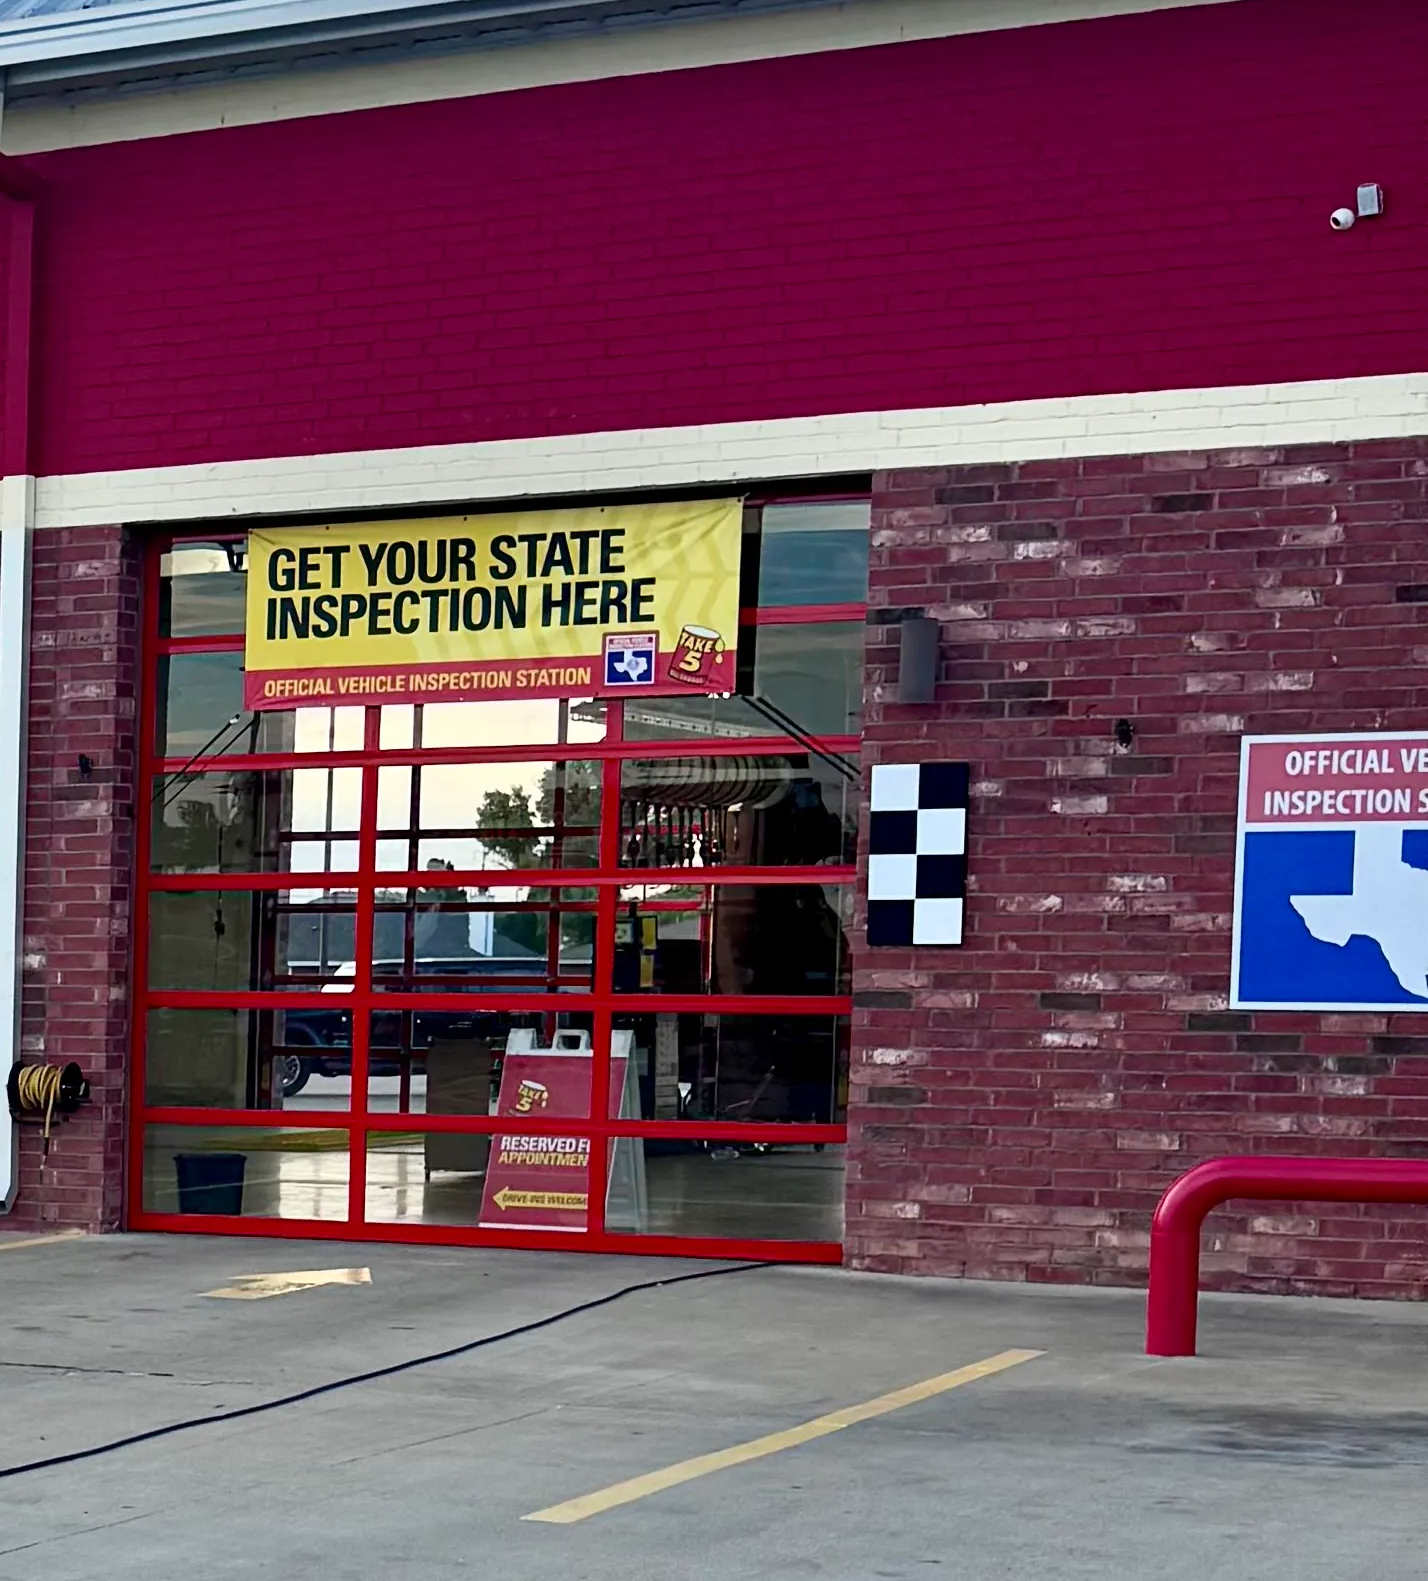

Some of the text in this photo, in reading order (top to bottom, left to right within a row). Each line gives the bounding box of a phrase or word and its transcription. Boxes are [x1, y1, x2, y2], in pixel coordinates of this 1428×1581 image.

[268, 527, 626, 592] GET YOUR STATE
[266, 577, 657, 640] INSPECTION HERE
[681, 632, 714, 653] TAKE
[679, 650, 702, 672] 5
[264, 666, 592, 697] OFFICIAL VEHICLE INSPECTION STATION
[1284, 747, 1428, 776] OFFICIAL VE
[1263, 788, 1428, 816] INSPECTION S
[500, 1135, 577, 1153] RESERVED
[498, 1151, 590, 1167] APPOINTMEN
[547, 1195, 588, 1206] WELCOM
